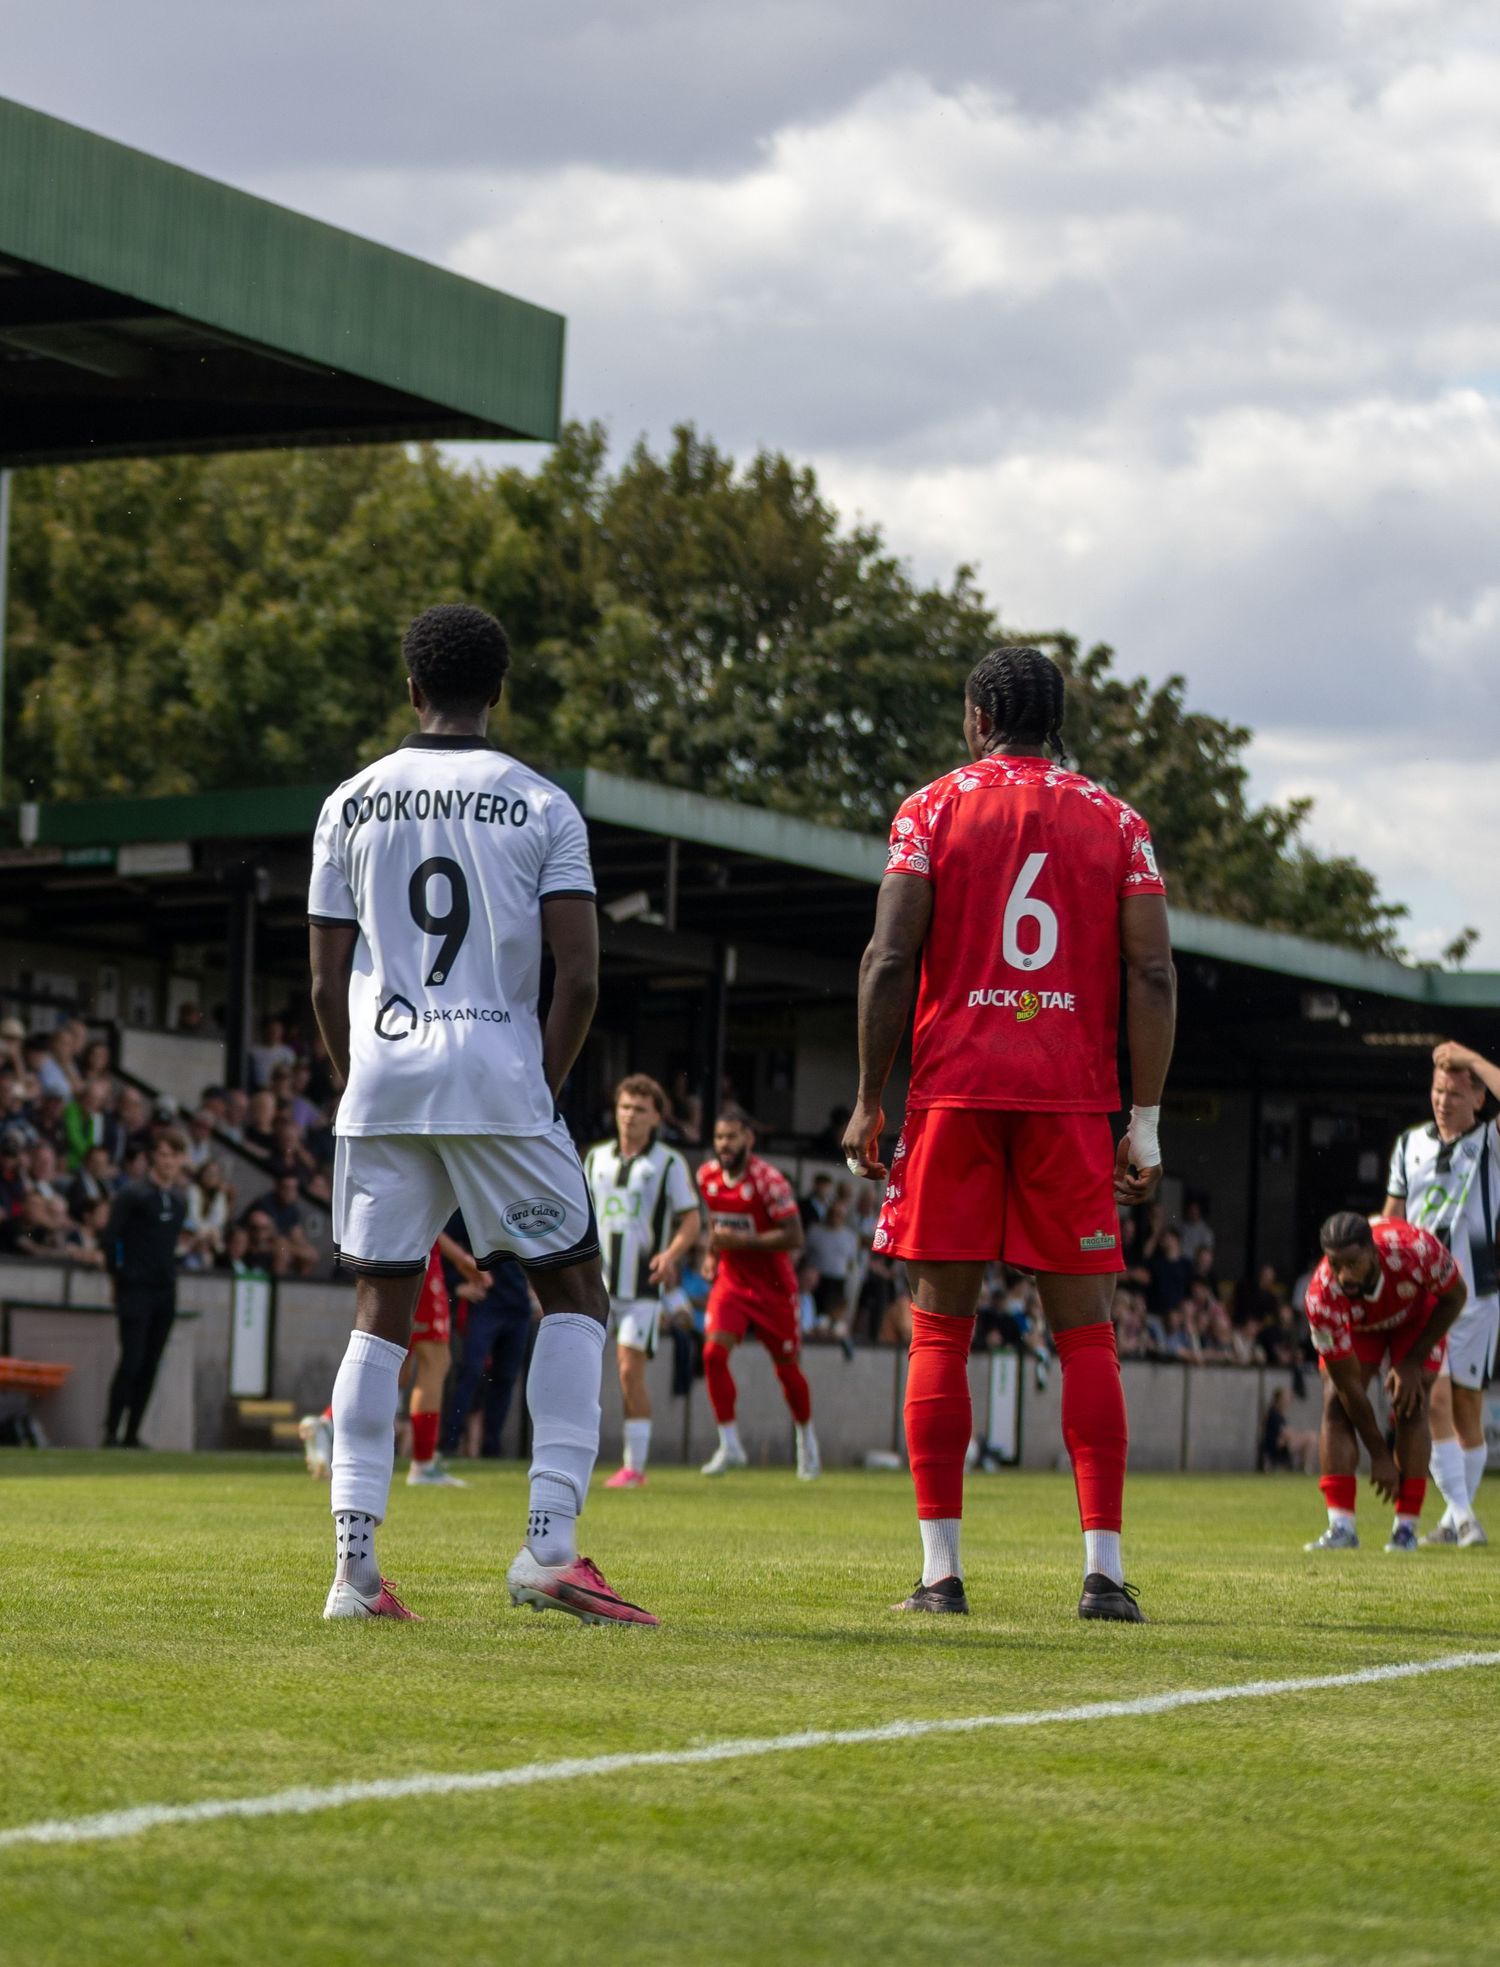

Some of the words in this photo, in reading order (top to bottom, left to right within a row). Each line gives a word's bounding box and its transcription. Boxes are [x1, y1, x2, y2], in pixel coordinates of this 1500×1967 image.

[342, 789, 528, 828] ODOKONYERO
[408, 856, 470, 987] 9
[1002, 853, 1058, 971] 6
[968, 989, 1019, 1007] DUCK
[531, 1204, 560, 1218] Glass
